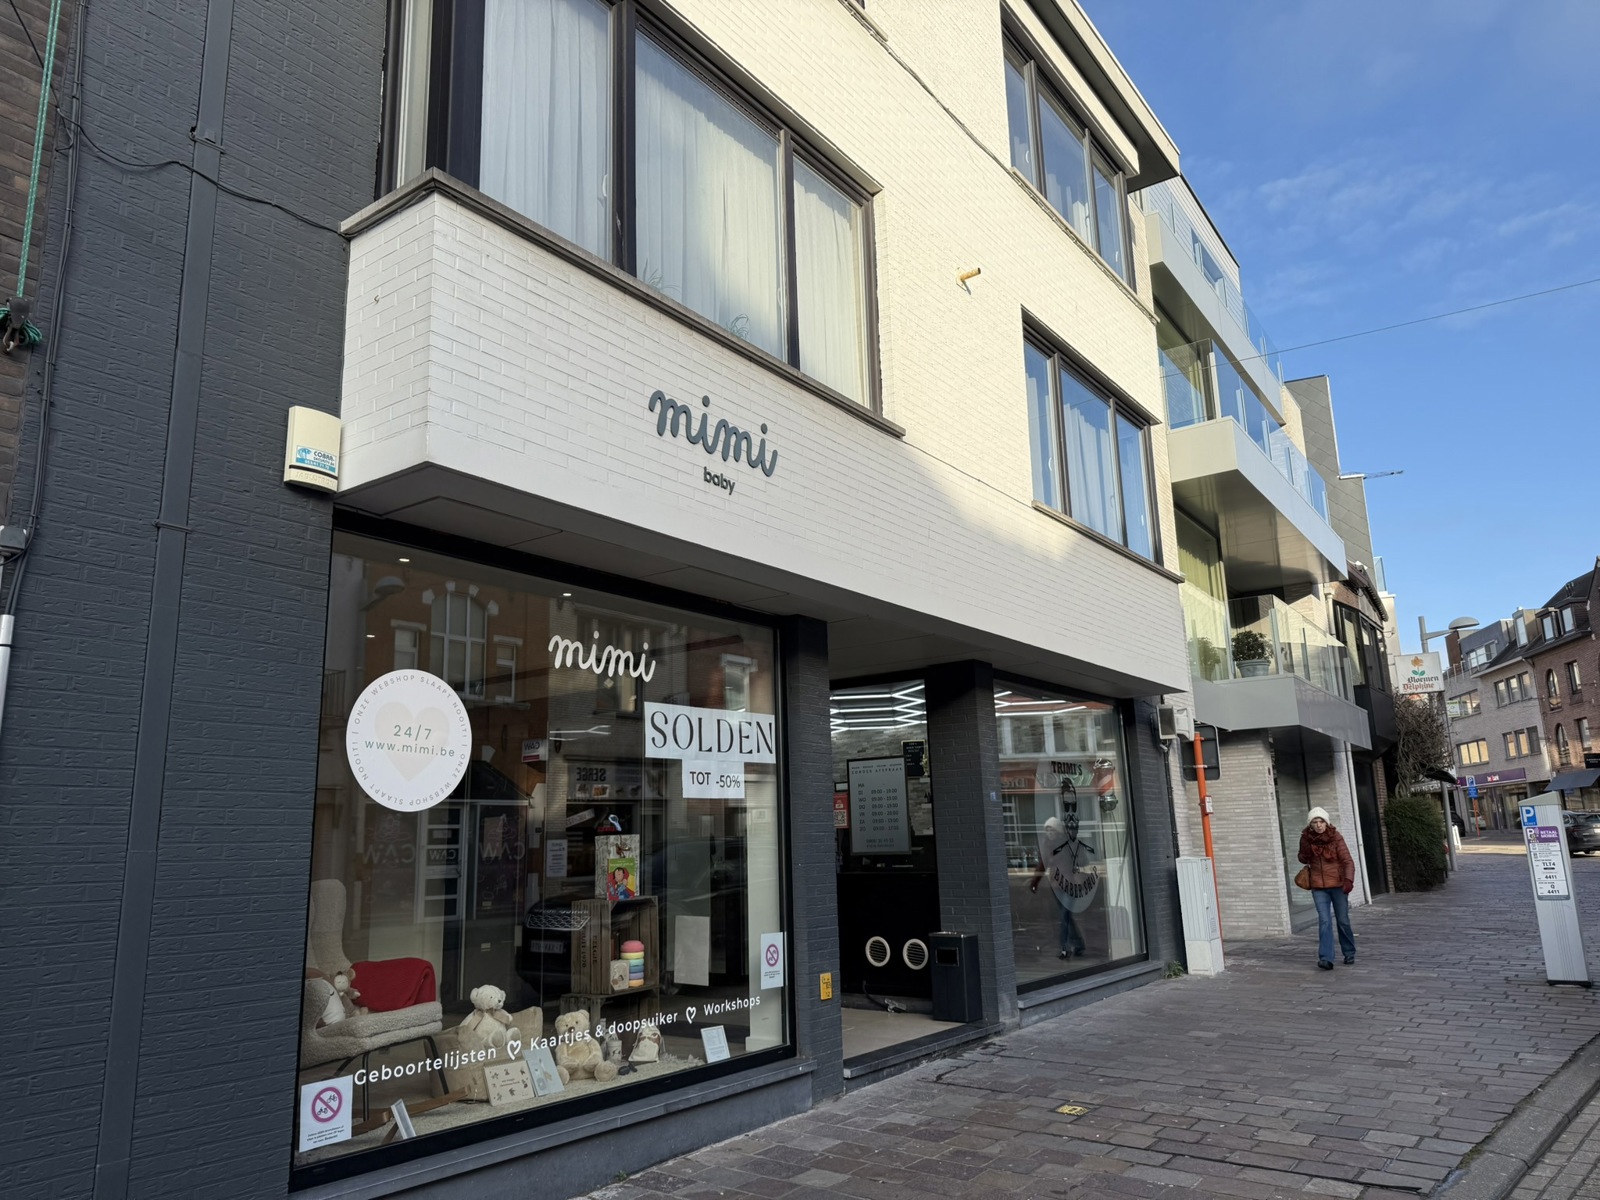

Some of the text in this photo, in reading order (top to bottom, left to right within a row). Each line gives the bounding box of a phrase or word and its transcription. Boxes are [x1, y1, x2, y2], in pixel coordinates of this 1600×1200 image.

[648, 390, 778, 477] mimi
[704, 466, 736, 496] baby
[548, 630, 656, 682] mimi
[354, 699, 370, 724] ONZE
[371, 674, 415, 696] WEBSHOP
[420, 676, 452, 699] SLAAPT
[393, 724, 432, 742] 24/7
[650, 710, 774, 754] SOLDEN
[364, 740, 455, 757] www.mimi.be
[452, 754, 466, 780] ONZE
[690, 771, 740, 788] TOT -50%
[370, 784, 403, 806] SLAAPT
[409, 782, 452, 806] WEBSHOP
[354, 1048, 496, 1085] Geboortelijsten
[530, 1029, 591, 1051] Kaartjes
[595, 1025, 604, 1037] &
[608, 1012, 678, 1034] doopsuiker
[704, 996, 761, 1016] Workshops
